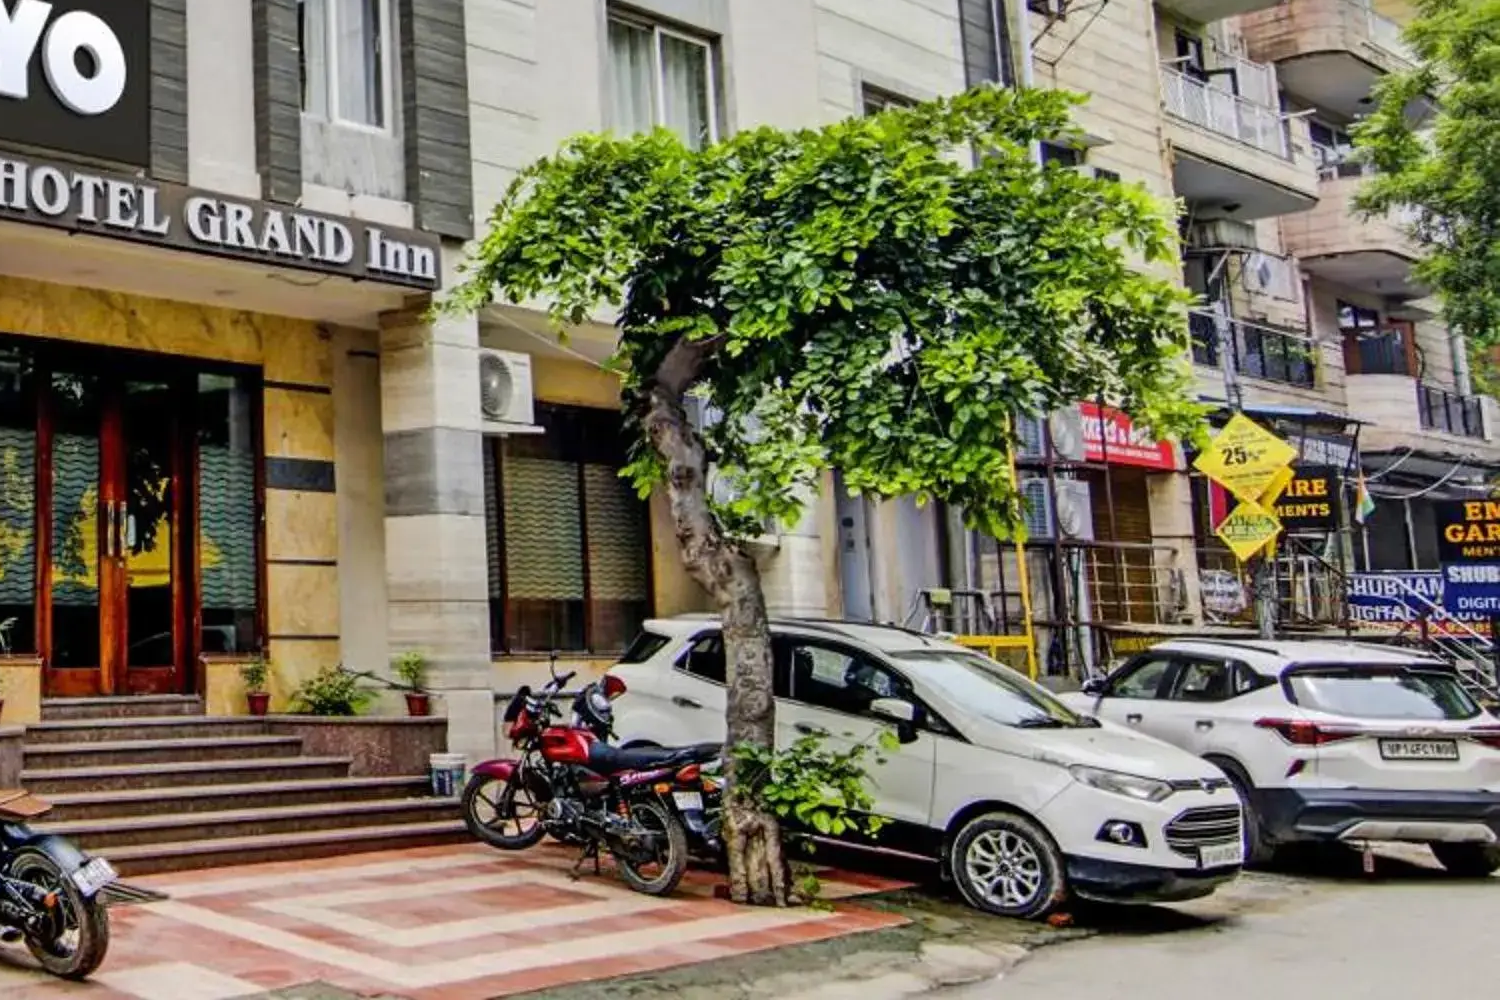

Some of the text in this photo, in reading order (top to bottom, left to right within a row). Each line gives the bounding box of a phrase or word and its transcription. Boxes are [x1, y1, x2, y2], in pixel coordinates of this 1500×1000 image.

[186, 197, 354, 266] GRAND
[365, 227, 437, 280] Inn
[1457, 596, 1500, 609] DIGIT
